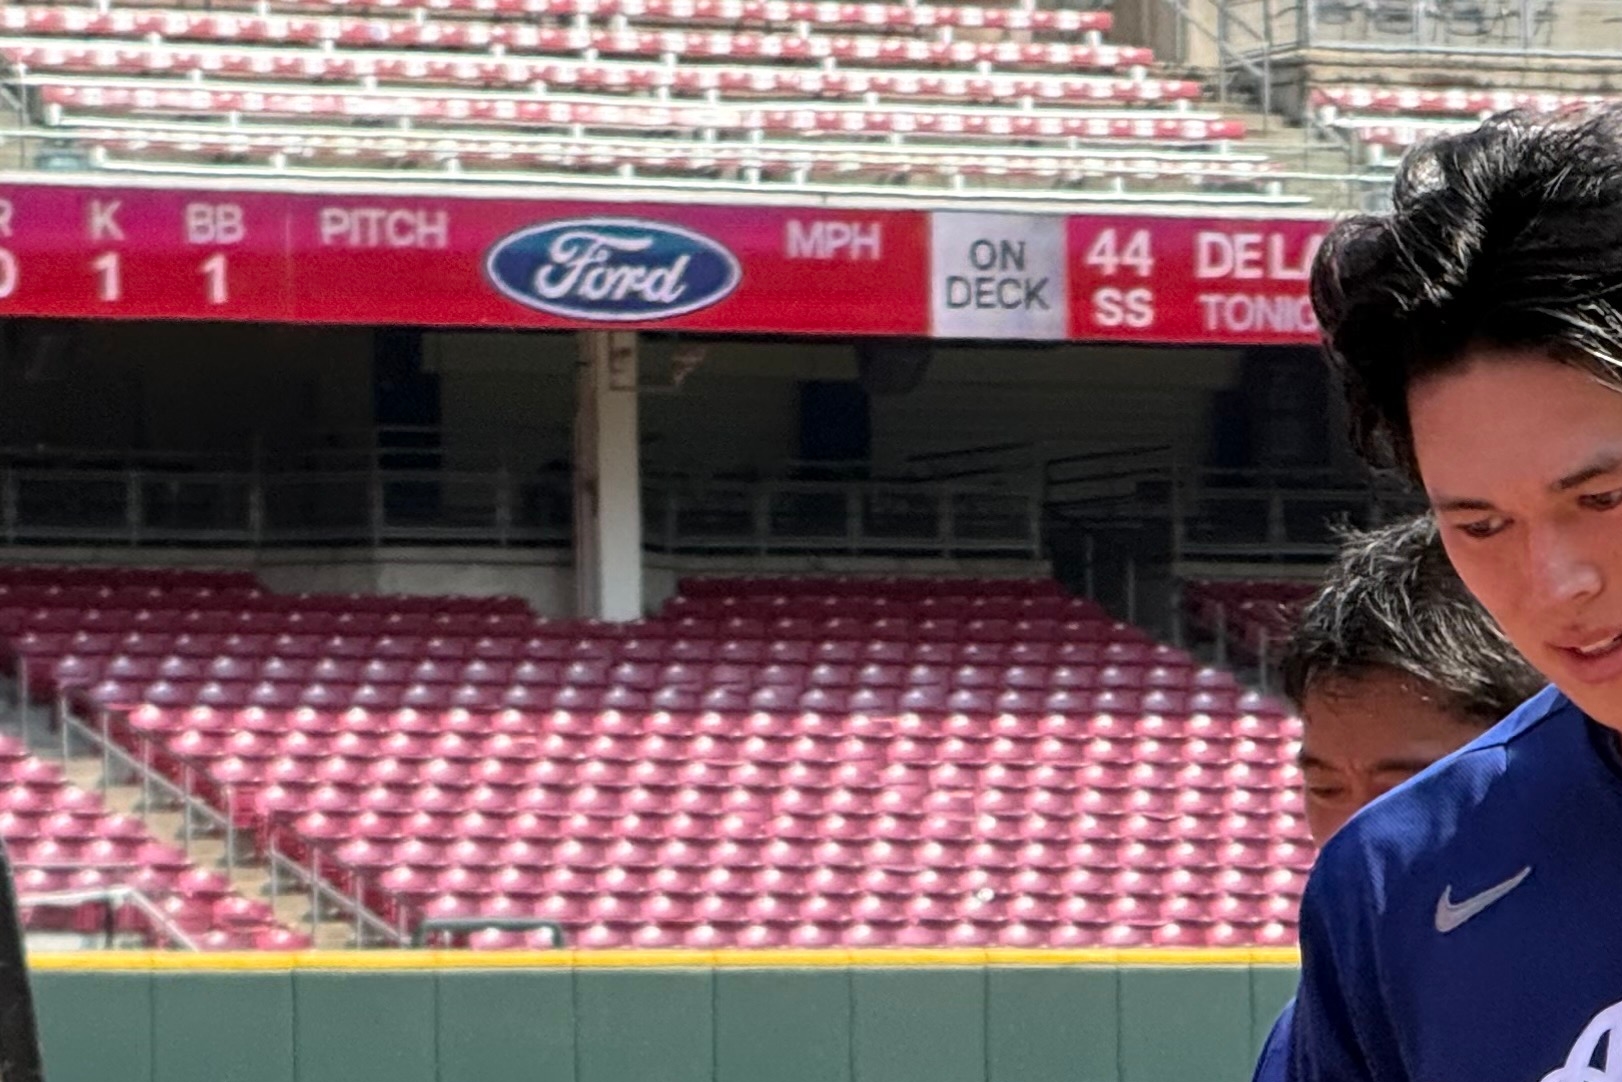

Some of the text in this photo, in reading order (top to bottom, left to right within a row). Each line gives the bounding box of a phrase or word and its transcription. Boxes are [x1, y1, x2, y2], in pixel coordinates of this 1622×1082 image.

[91, 199, 125, 241] K
[185, 201, 243, 244] BB
[320, 206, 450, 248] PITCH
[784, 218, 882, 261] MPH
[534, 230, 691, 304] Ford
[969, 239, 1026, 271] ON
[1086, 228, 1153, 278] 44
[93, 252, 121, 301] 1
[202, 254, 231, 304] 1
[945, 276, 1050, 311] DECK
[1094, 287, 1154, 328] SS
